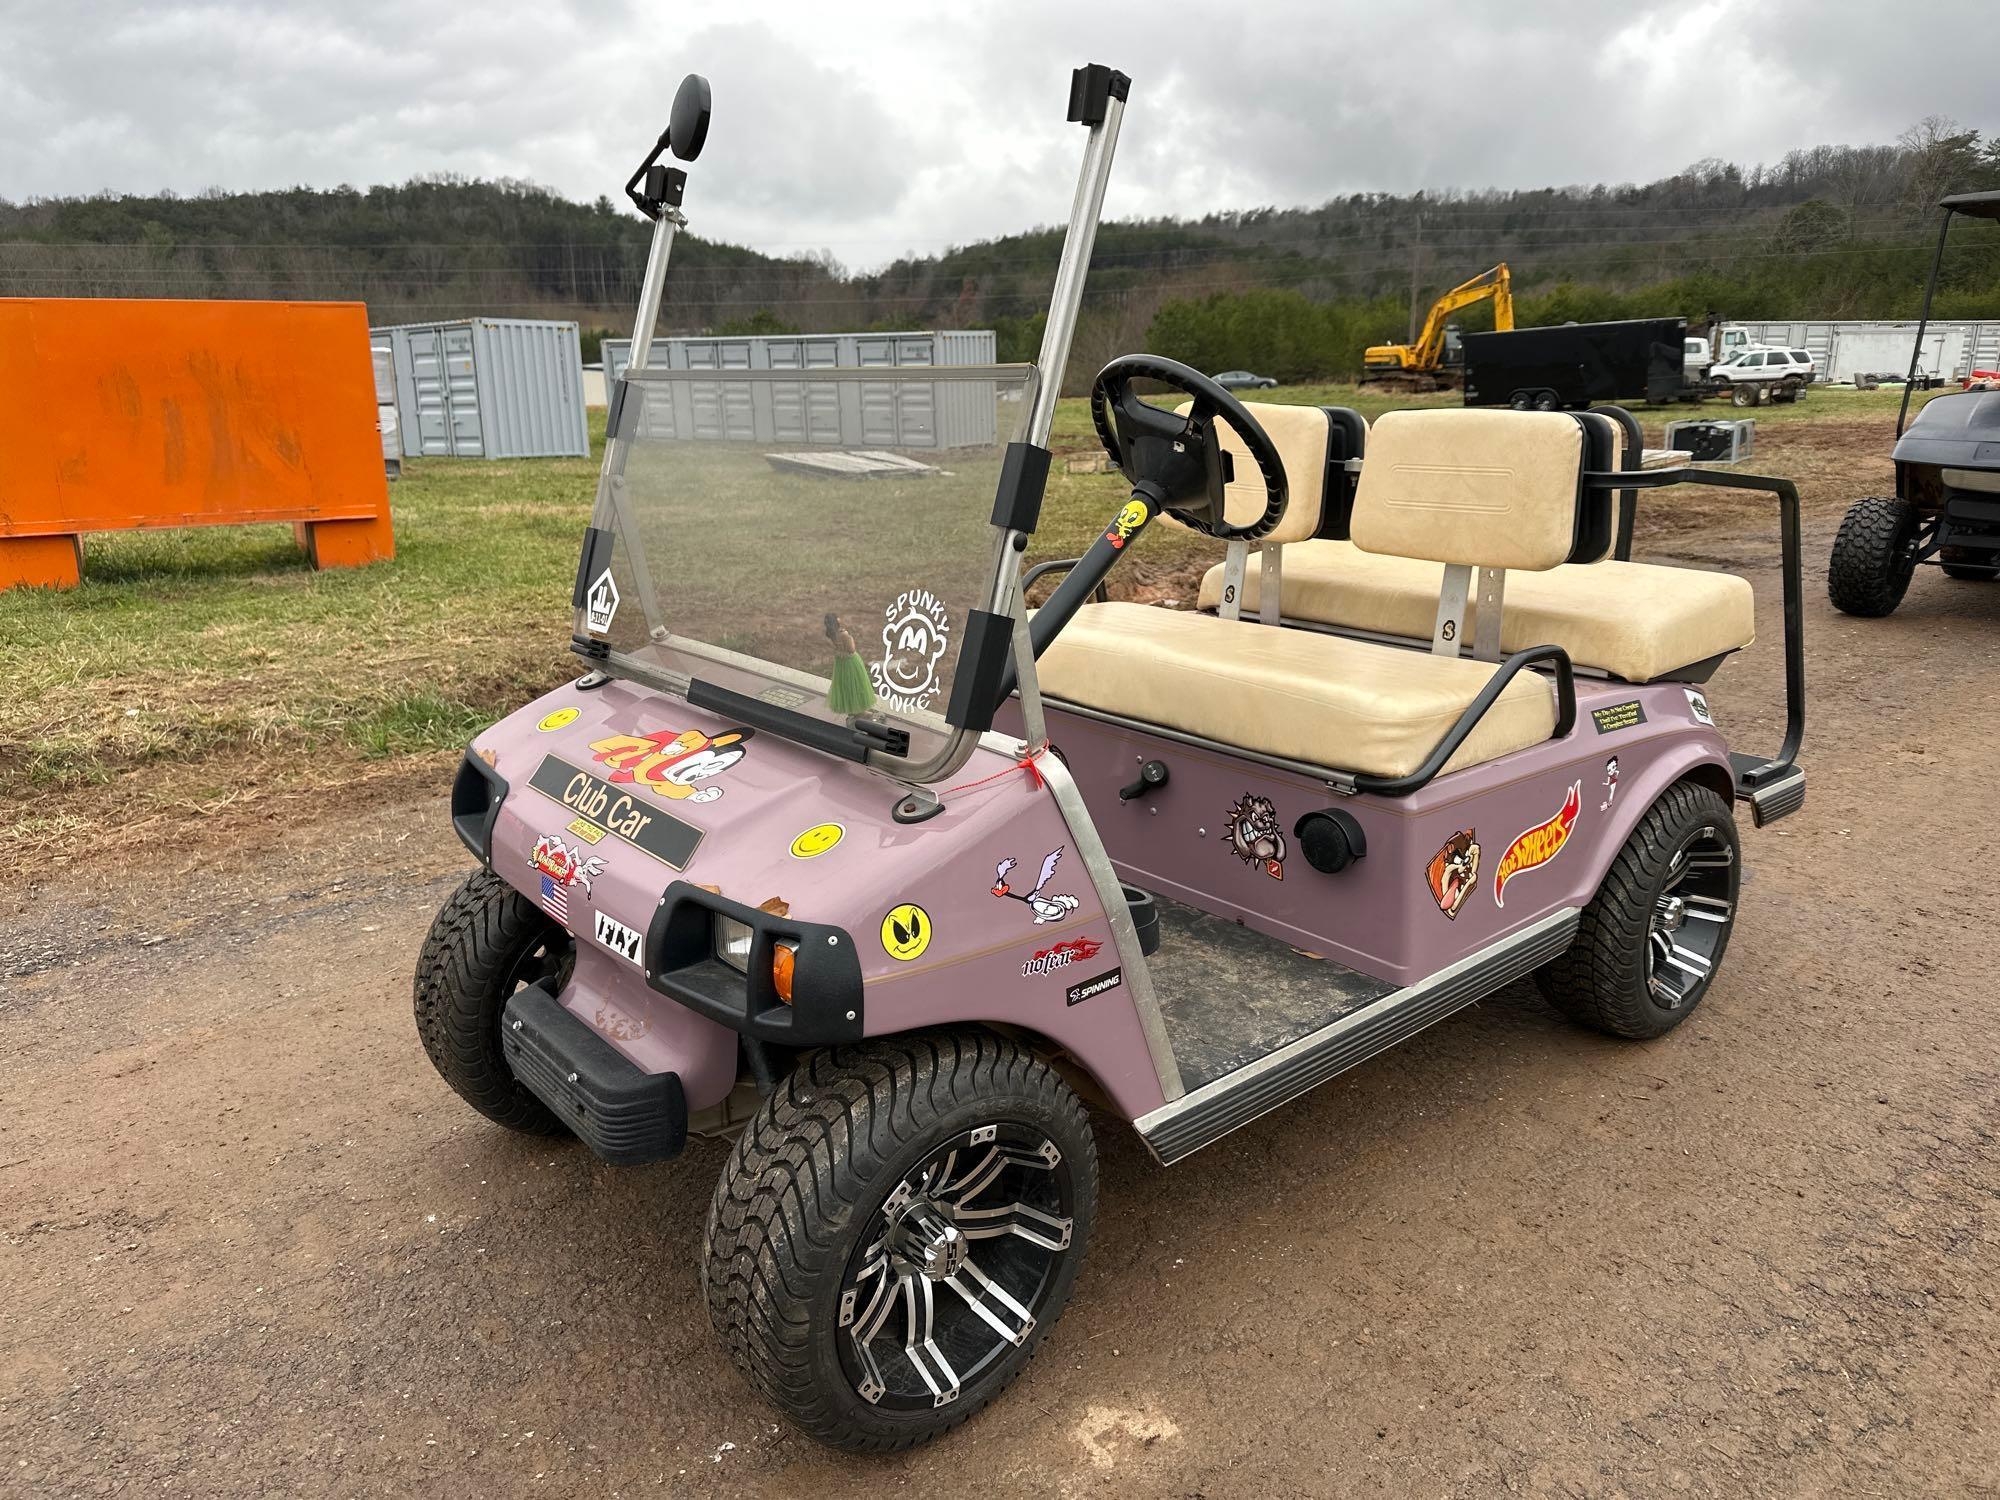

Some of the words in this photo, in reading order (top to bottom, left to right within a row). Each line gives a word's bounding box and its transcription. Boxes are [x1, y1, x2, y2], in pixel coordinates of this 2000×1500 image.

[886, 589, 949, 632] SPUNKY
[870, 662, 941, 714] MONKEY
[563, 772, 608, 818] Club
[606, 795, 652, 840] Car
[1080, 974, 1119, 999] SPINNING
